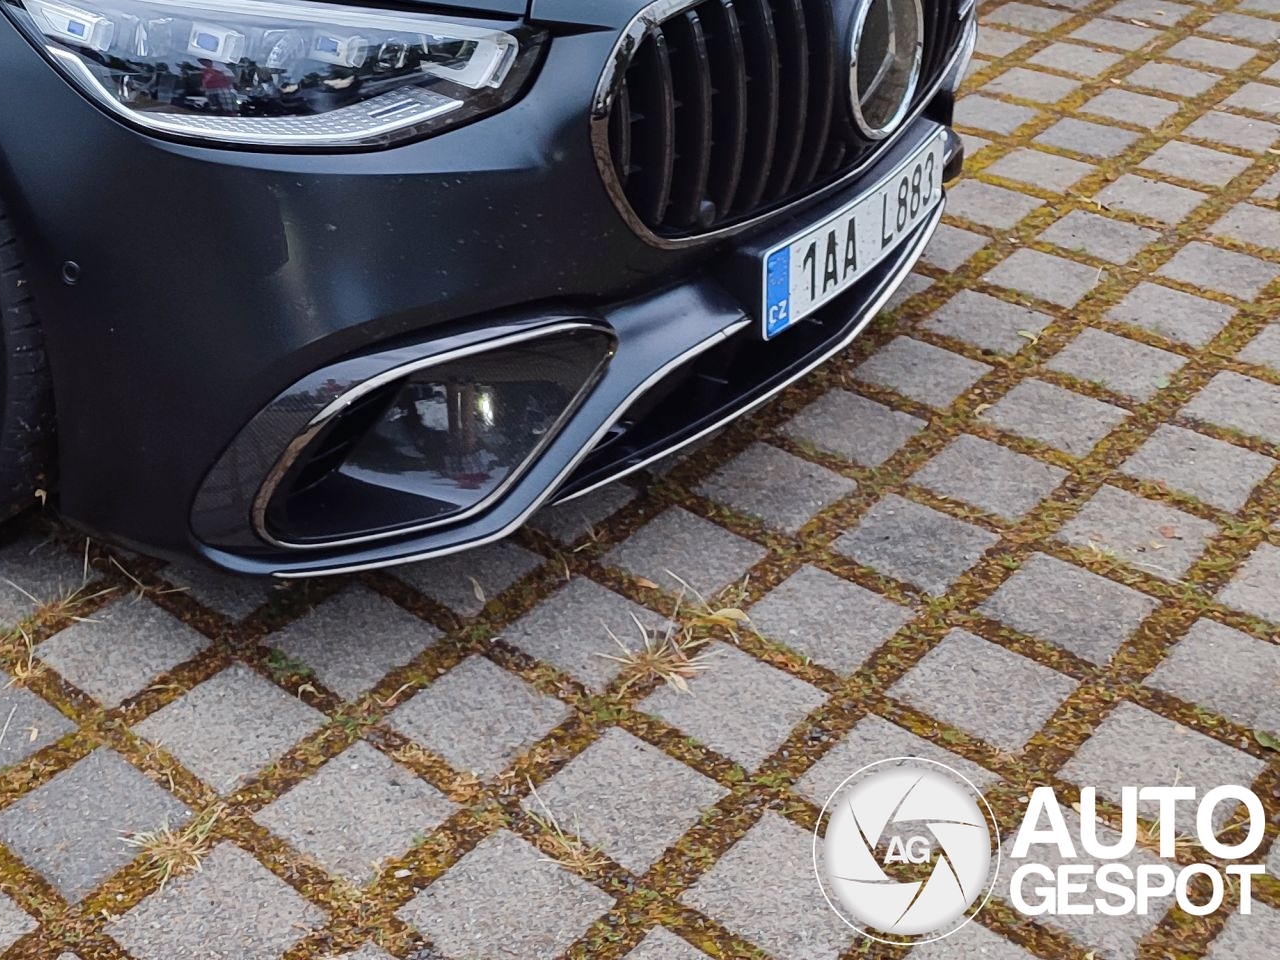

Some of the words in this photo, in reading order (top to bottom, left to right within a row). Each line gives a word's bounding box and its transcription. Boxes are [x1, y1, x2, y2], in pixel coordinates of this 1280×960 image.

[802, 216, 858, 302] 1AA
[880, 151, 935, 251] L883
[768, 300, 788, 325] CZ
